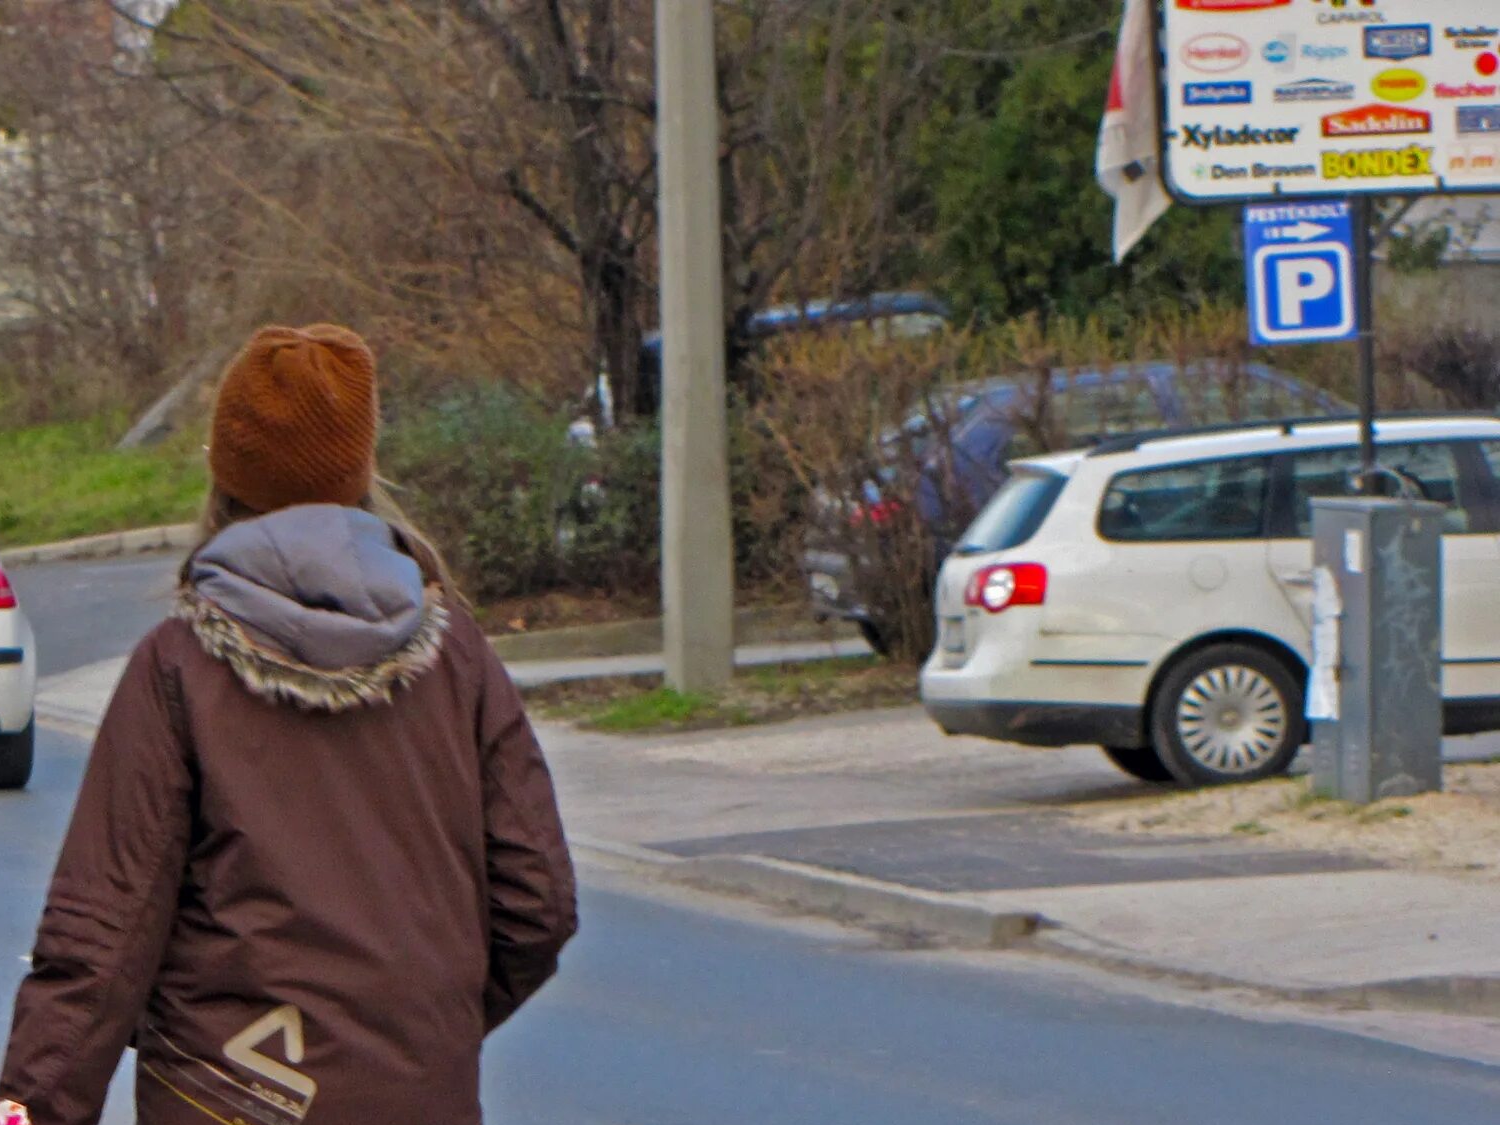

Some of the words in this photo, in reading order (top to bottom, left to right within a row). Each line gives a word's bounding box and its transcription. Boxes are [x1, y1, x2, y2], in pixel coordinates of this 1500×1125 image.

[1181, 122, 1301, 150] Xyladecor
[1329, 112, 1424, 132] Sadolin
[1211, 163, 1249, 179] Den
[1321, 146, 1435, 180] BONDEX
[1277, 258, 1334, 326] P
